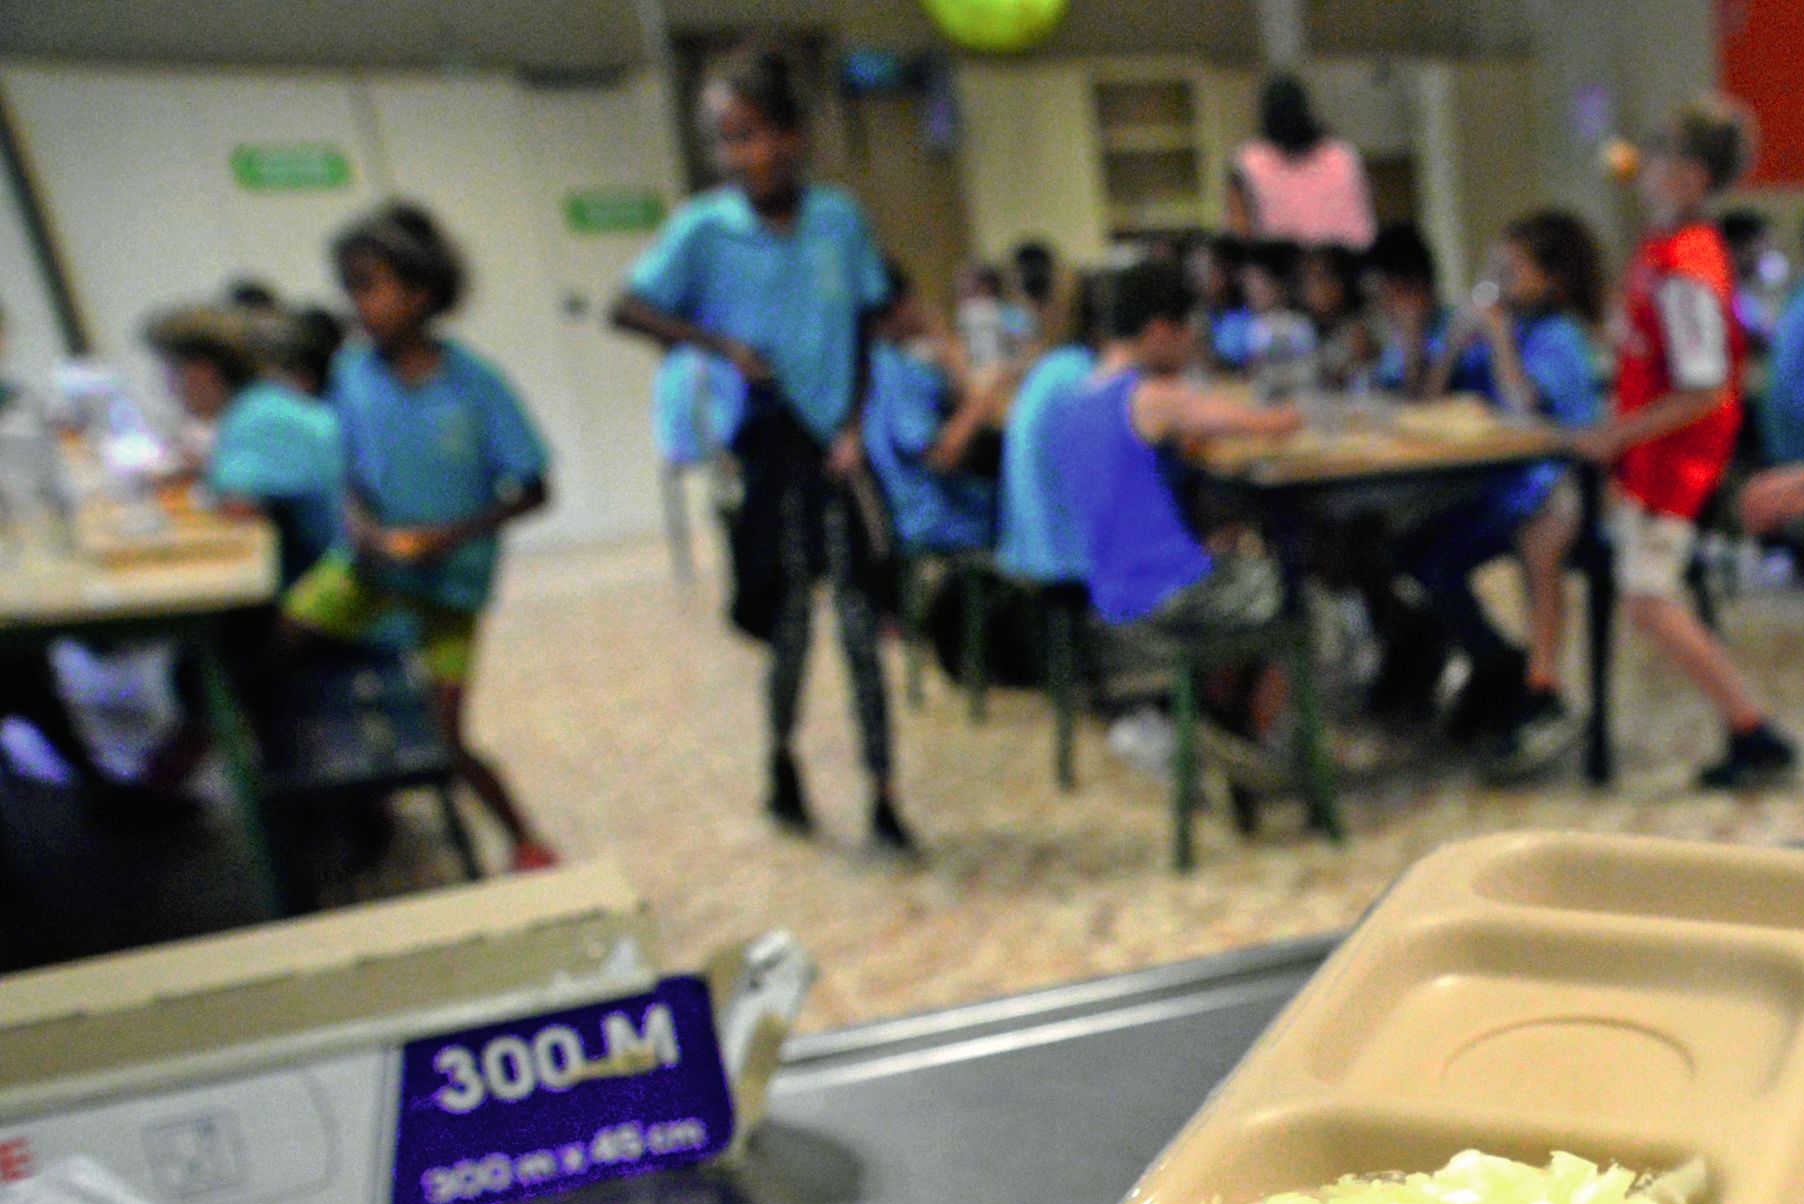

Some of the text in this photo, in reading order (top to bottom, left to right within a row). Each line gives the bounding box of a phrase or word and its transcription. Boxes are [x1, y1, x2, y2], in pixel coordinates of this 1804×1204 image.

[432, 1003, 680, 1113] 300 M
[515, 1150, 558, 1184] m
[647, 1117, 709, 1154] cm
